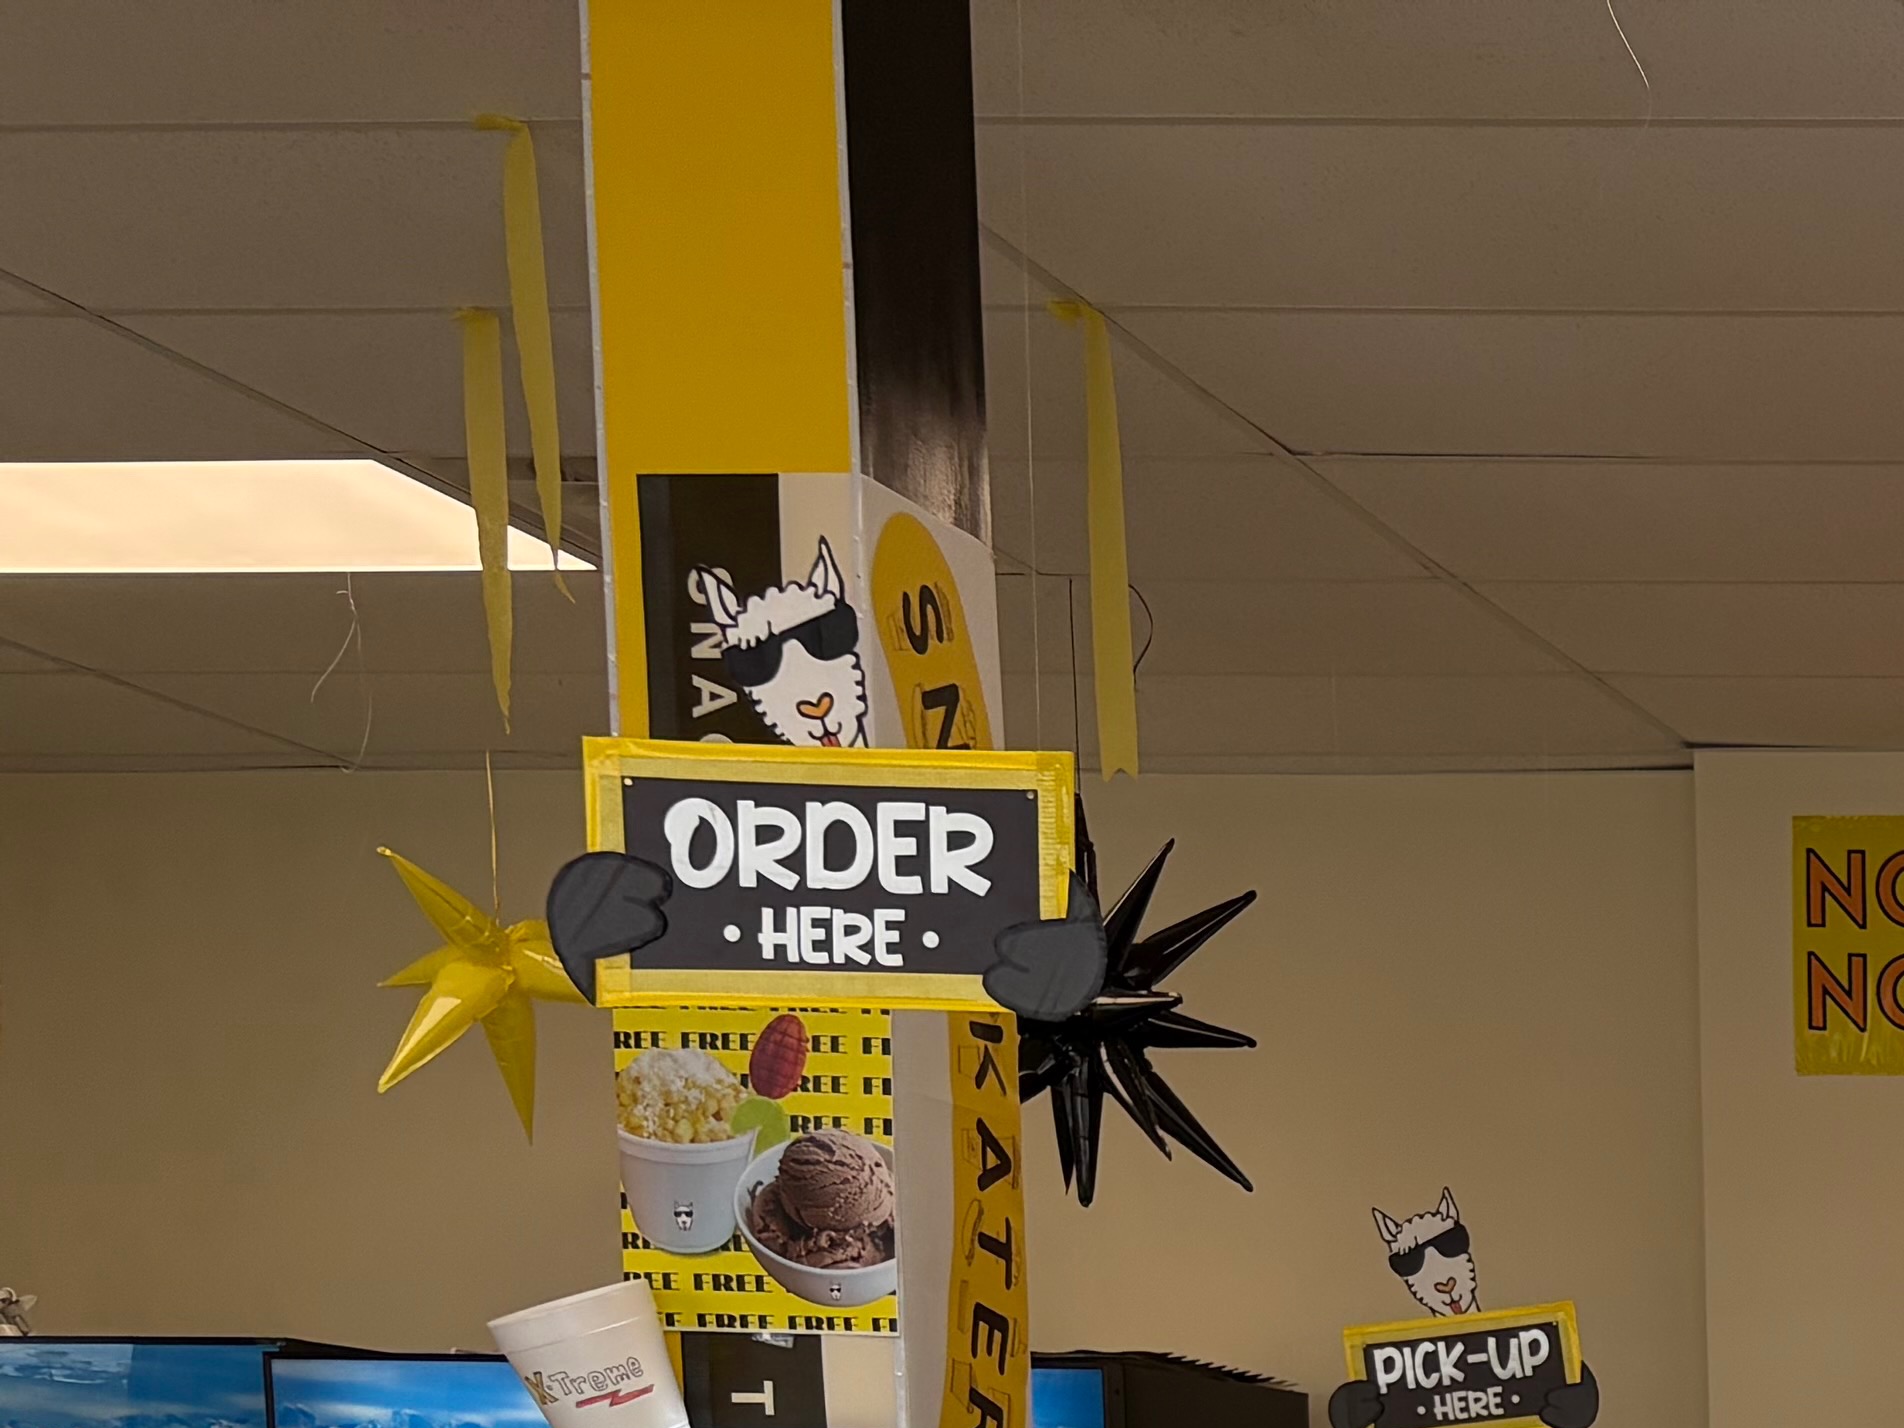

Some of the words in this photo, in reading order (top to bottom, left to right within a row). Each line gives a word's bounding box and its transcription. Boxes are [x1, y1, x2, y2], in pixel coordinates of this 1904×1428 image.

[664, 797, 995, 898] ORDER
[757, 906, 906, 967] HERE
[680, 1031, 757, 1051] FREE
[693, 1273, 774, 1293] FREE
[696, 1312, 775, 1330] FREE
[787, 1314, 859, 1332] FREE
[1373, 1328, 1549, 1393] PICK-UP
[1433, 1387, 1504, 1420] HERE
